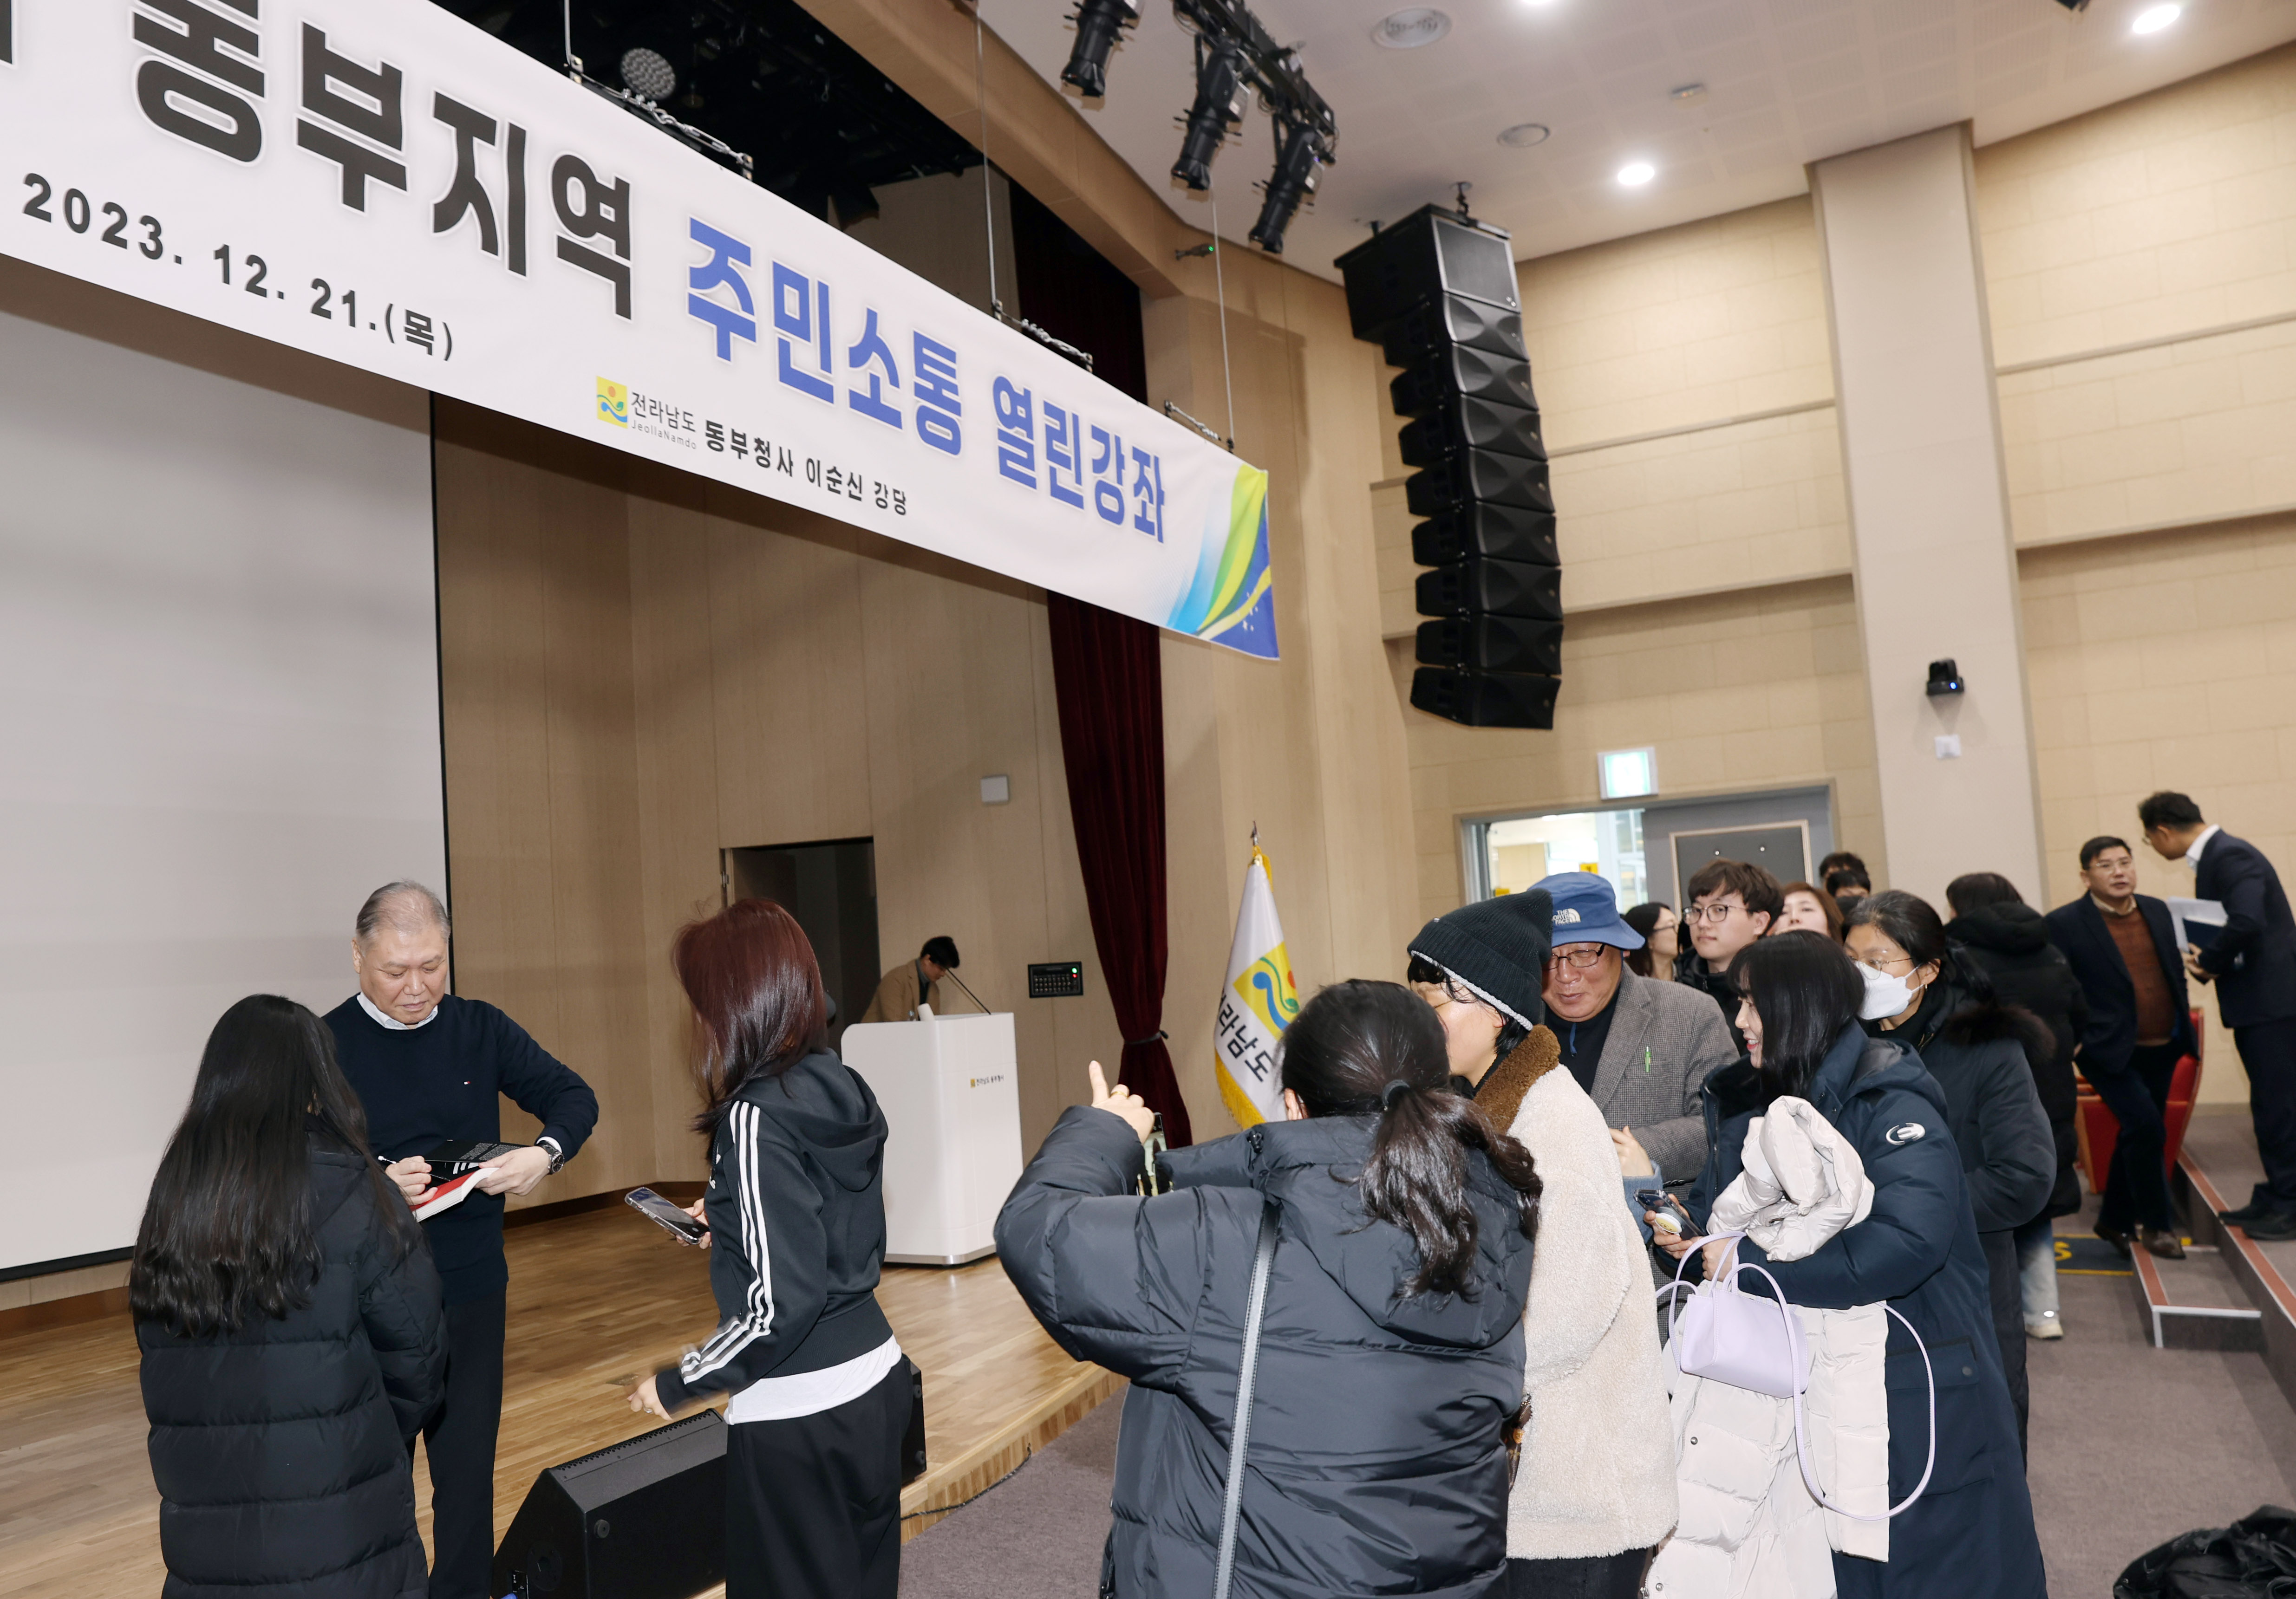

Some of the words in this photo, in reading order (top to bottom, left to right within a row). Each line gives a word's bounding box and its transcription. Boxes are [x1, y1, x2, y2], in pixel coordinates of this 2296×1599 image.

[24, 173, 182, 265] 2023.
[215, 245, 284, 300] 12.
[311, 279, 452, 362] 21.(목)
[134, 0, 631, 320] 동부지역
[689, 218, 962, 456] 주민소통
[993, 377, 1165, 543] 열린강좌
[632, 419, 697, 449] JeollaNamdo
[632, 392, 696, 433] 전라남도
[705, 420, 794, 477] 동부청사
[807, 458, 862, 502] 이순신
[874, 482, 907, 515] 강당
[1552, 913, 1570, 922] ORTH
